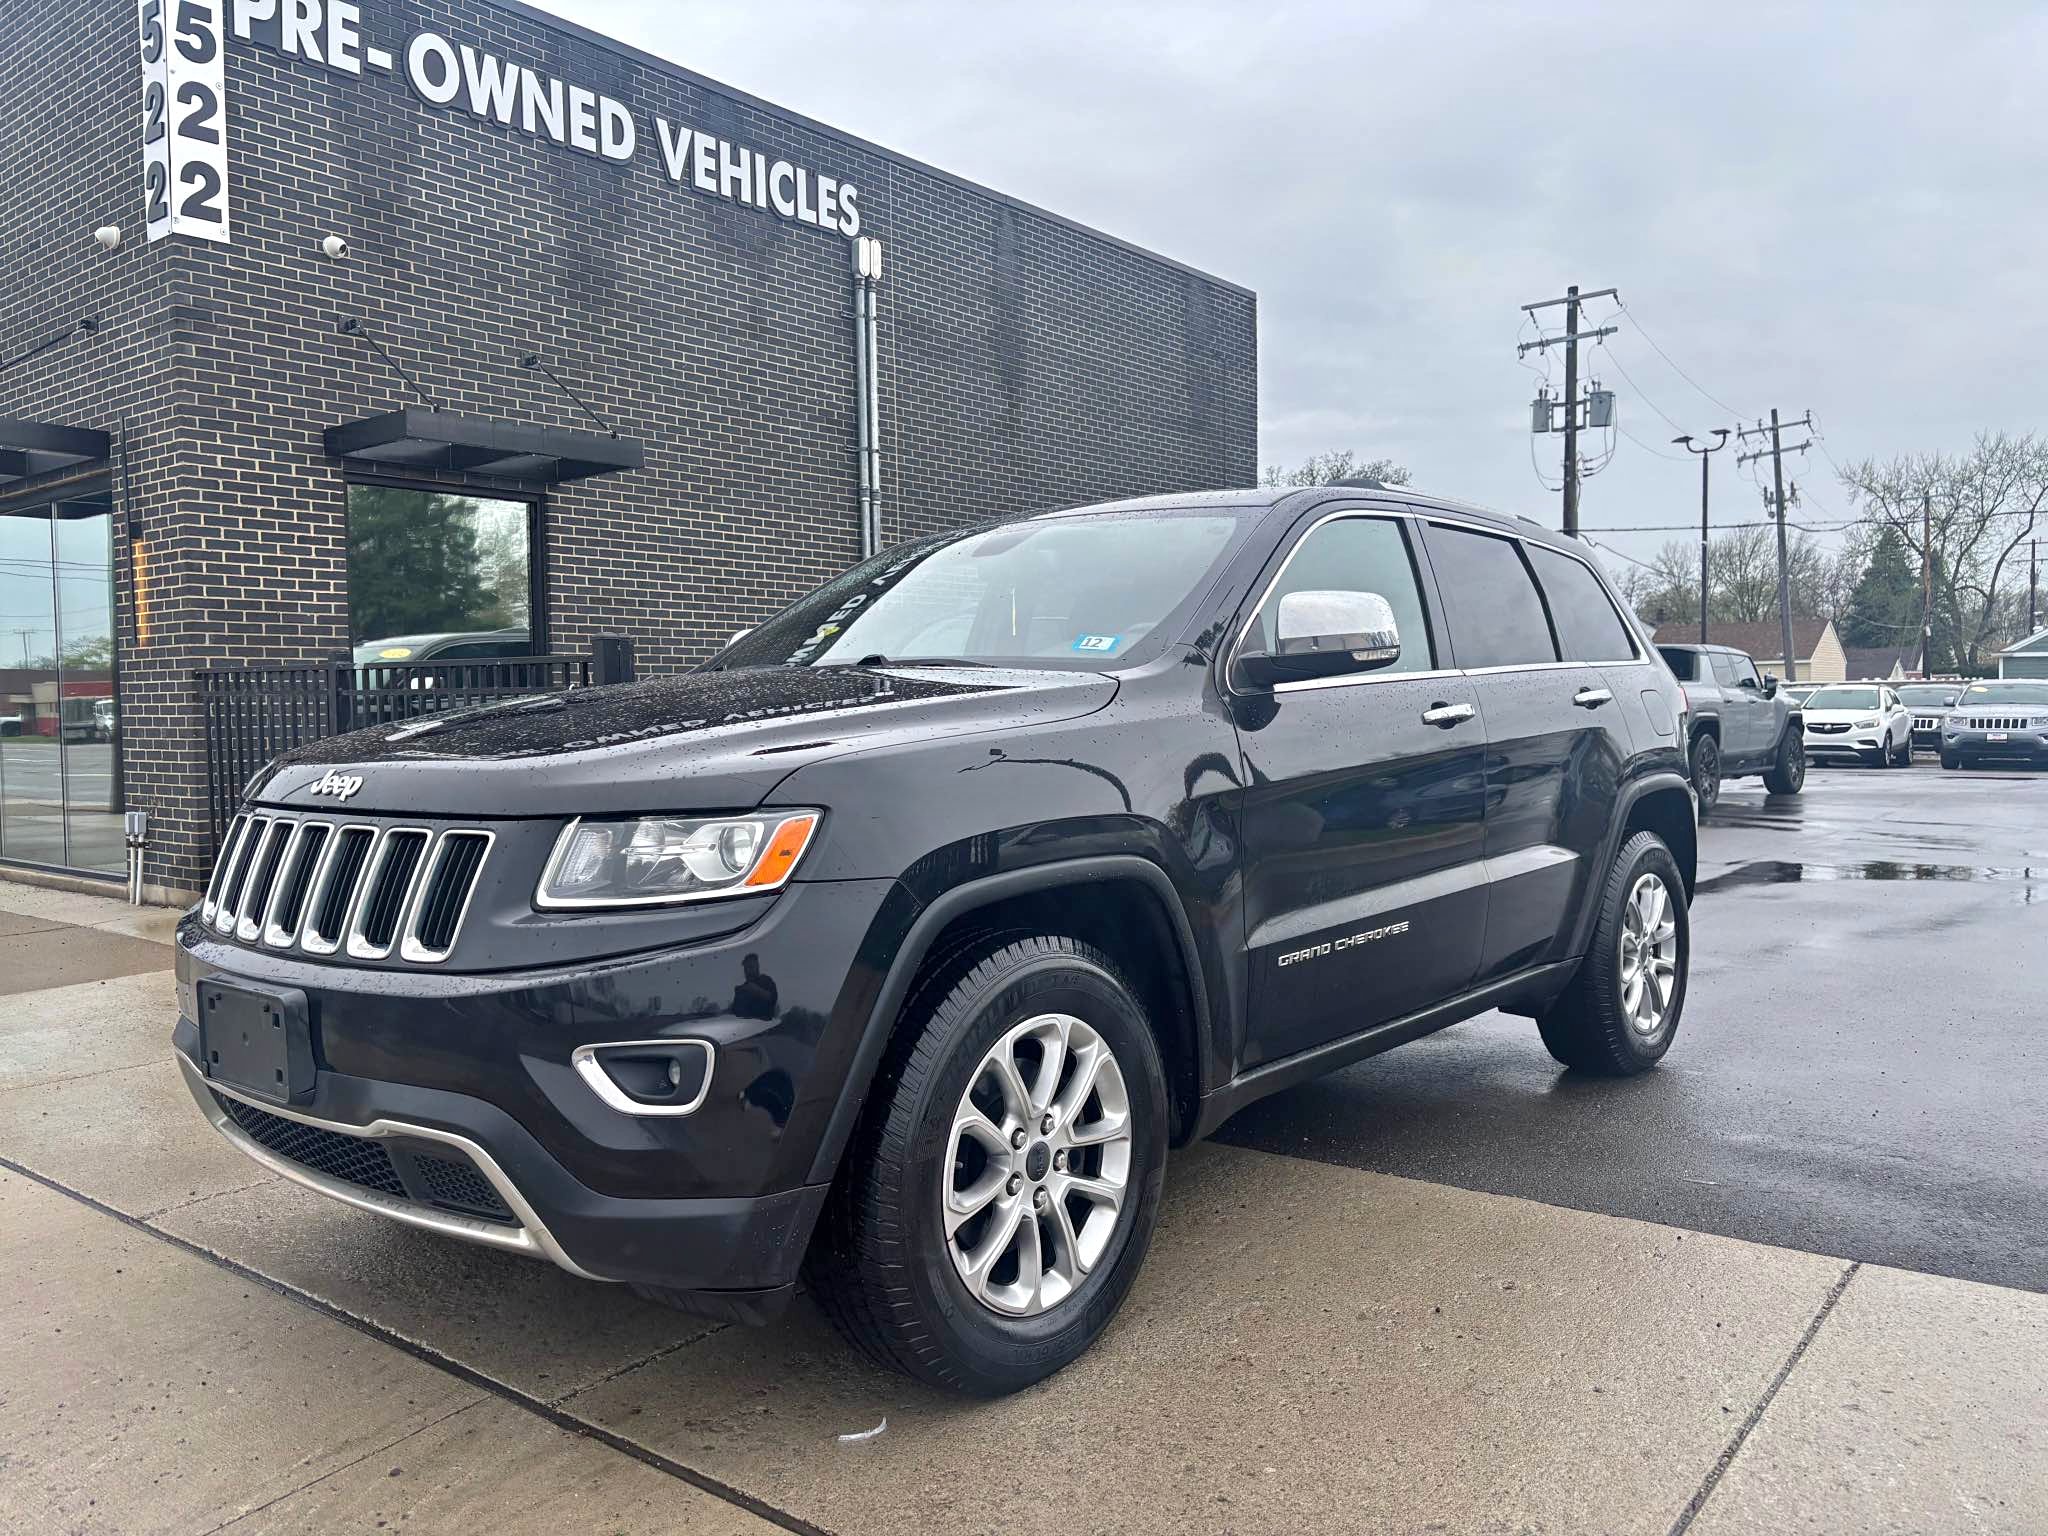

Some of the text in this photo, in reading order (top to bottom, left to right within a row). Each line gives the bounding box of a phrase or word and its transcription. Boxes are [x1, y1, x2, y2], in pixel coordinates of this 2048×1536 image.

[408, 33, 636, 161] OWNED
[655, 117, 861, 238] VEHICLES
[1081, 637, 1104, 648] 12
[310, 768, 364, 802] Jeep
[1277, 920, 1411, 968] GRAND CHEROKEE
